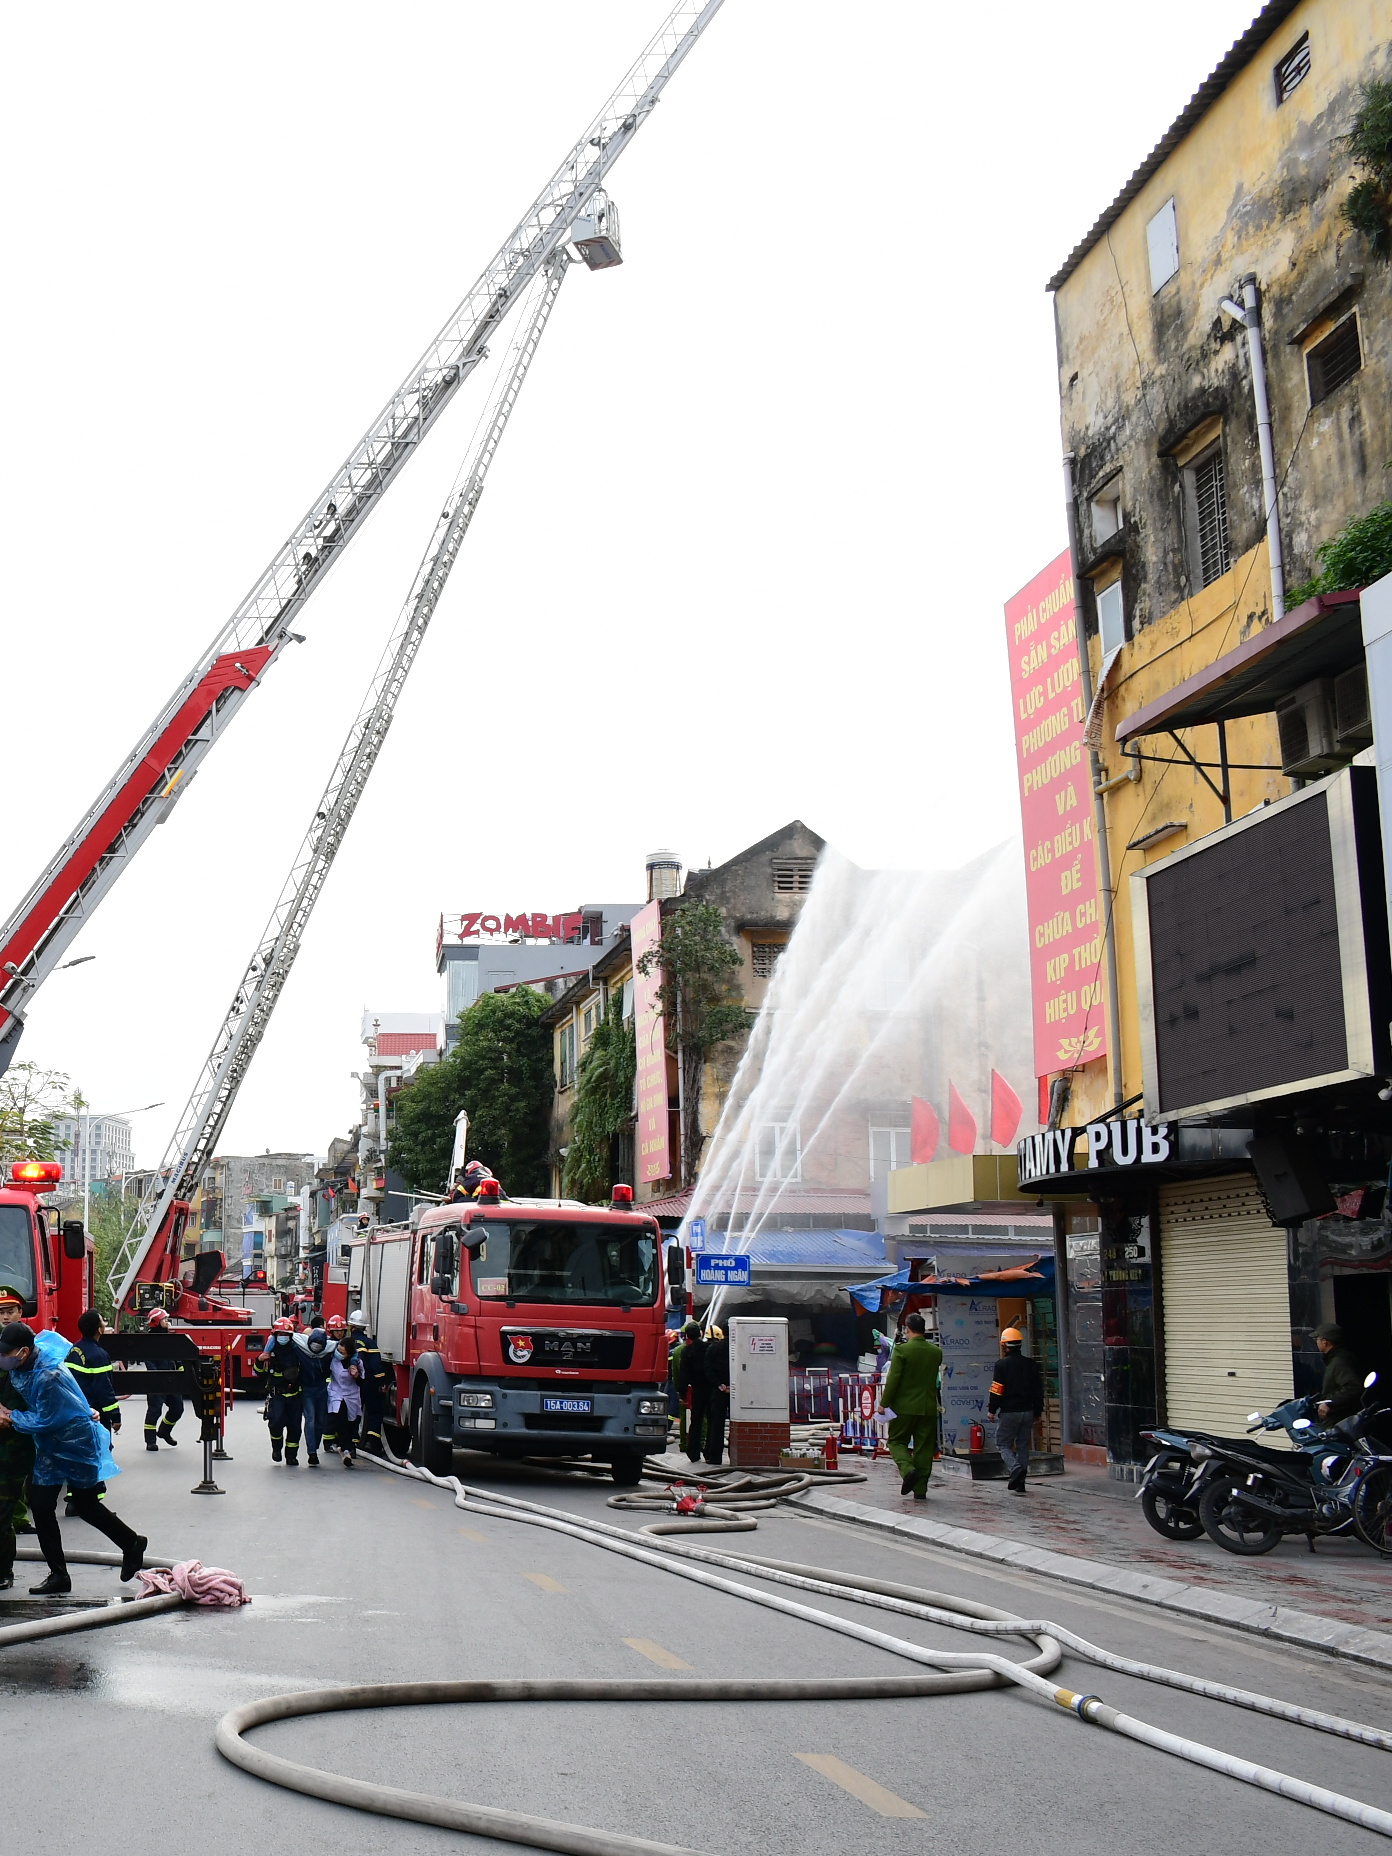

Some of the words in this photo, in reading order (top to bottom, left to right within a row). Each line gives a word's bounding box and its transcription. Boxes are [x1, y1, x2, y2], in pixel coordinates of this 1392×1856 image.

[1014, 605, 1038, 646] PHẢI
[1039, 574, 1075, 624] CHUẨN
[1021, 641, 1048, 679] SẴN
[1019, 684, 1044, 720] LỰC
[1022, 707, 1069, 758] PHƯƠNG
[1024, 740, 1081, 797] PHƯƠNG
[1055, 781, 1078, 816] VÀ
[1030, 840, 1052, 872] CÁC
[1054, 820, 1081, 859] ĐIỀU
[1061, 853, 1082, 896] ĐỂ
[458, 912, 584, 944] ZOMBIE
[1035, 911, 1073, 949] CHỮA
[1076, 898, 1098, 929] CH
[1046, 953, 1069, 985] KỊP
[1045, 990, 1077, 1024] HIỆU
[1081, 980, 1104, 1012] QU
[171, 1152, 189, 1184] MAGIRUS
[1018, 1128, 1072, 1182] TAMY
[1087, 1118, 1170, 1169] PUB
[711, 1257, 736, 1267] PHỐ
[1124, 1246, 1138, 1259] 250
[701, 1268, 726, 1281] HOÀNG
[728, 1269, 748, 1282] NGÂN
[969, 1299, 997, 1312] ALRAD
[544, 1340, 591, 1352] MAN
